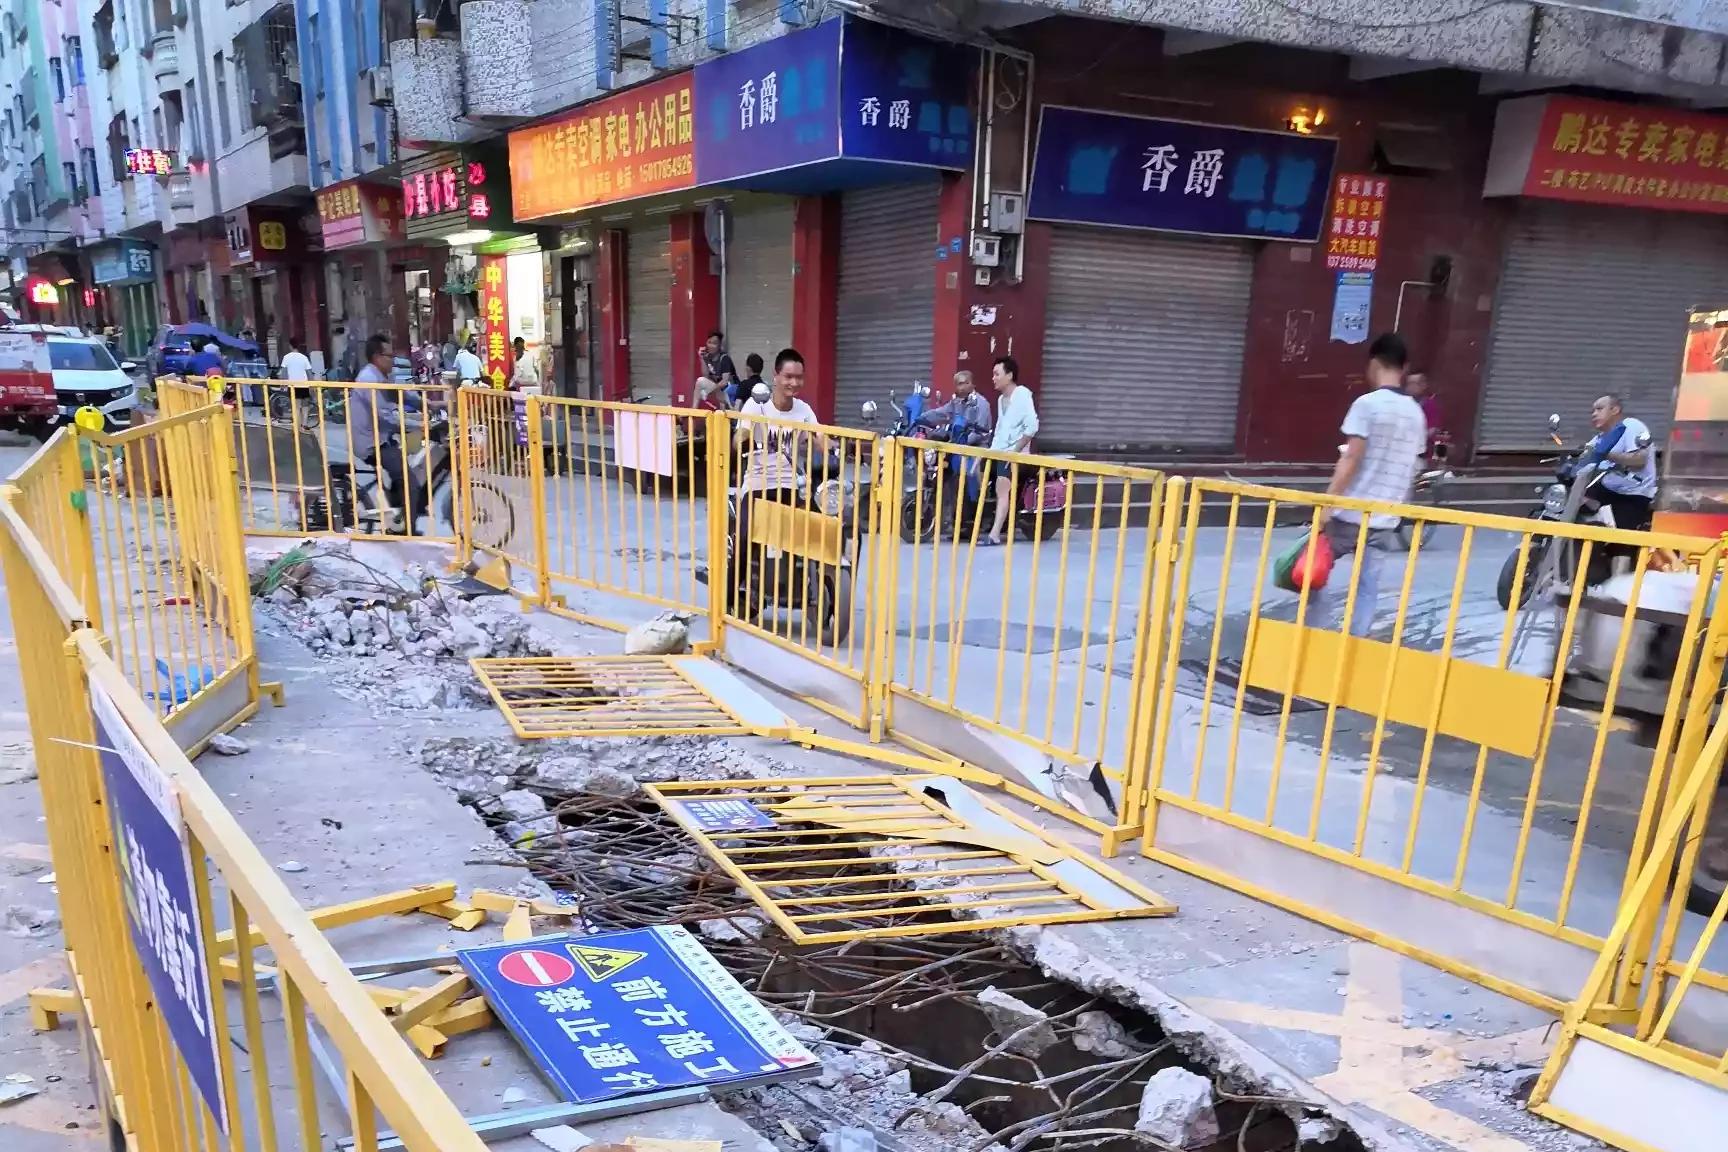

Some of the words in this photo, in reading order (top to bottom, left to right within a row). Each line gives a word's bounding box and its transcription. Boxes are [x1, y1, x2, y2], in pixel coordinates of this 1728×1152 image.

[738, 71, 778, 130] 香爵
[858, 96, 912, 130] 香爵
[1140, 144, 1225, 198] 香爵
[534, 987, 662, 1090] 禁止通行
[611, 976, 739, 1078] 前方施工
